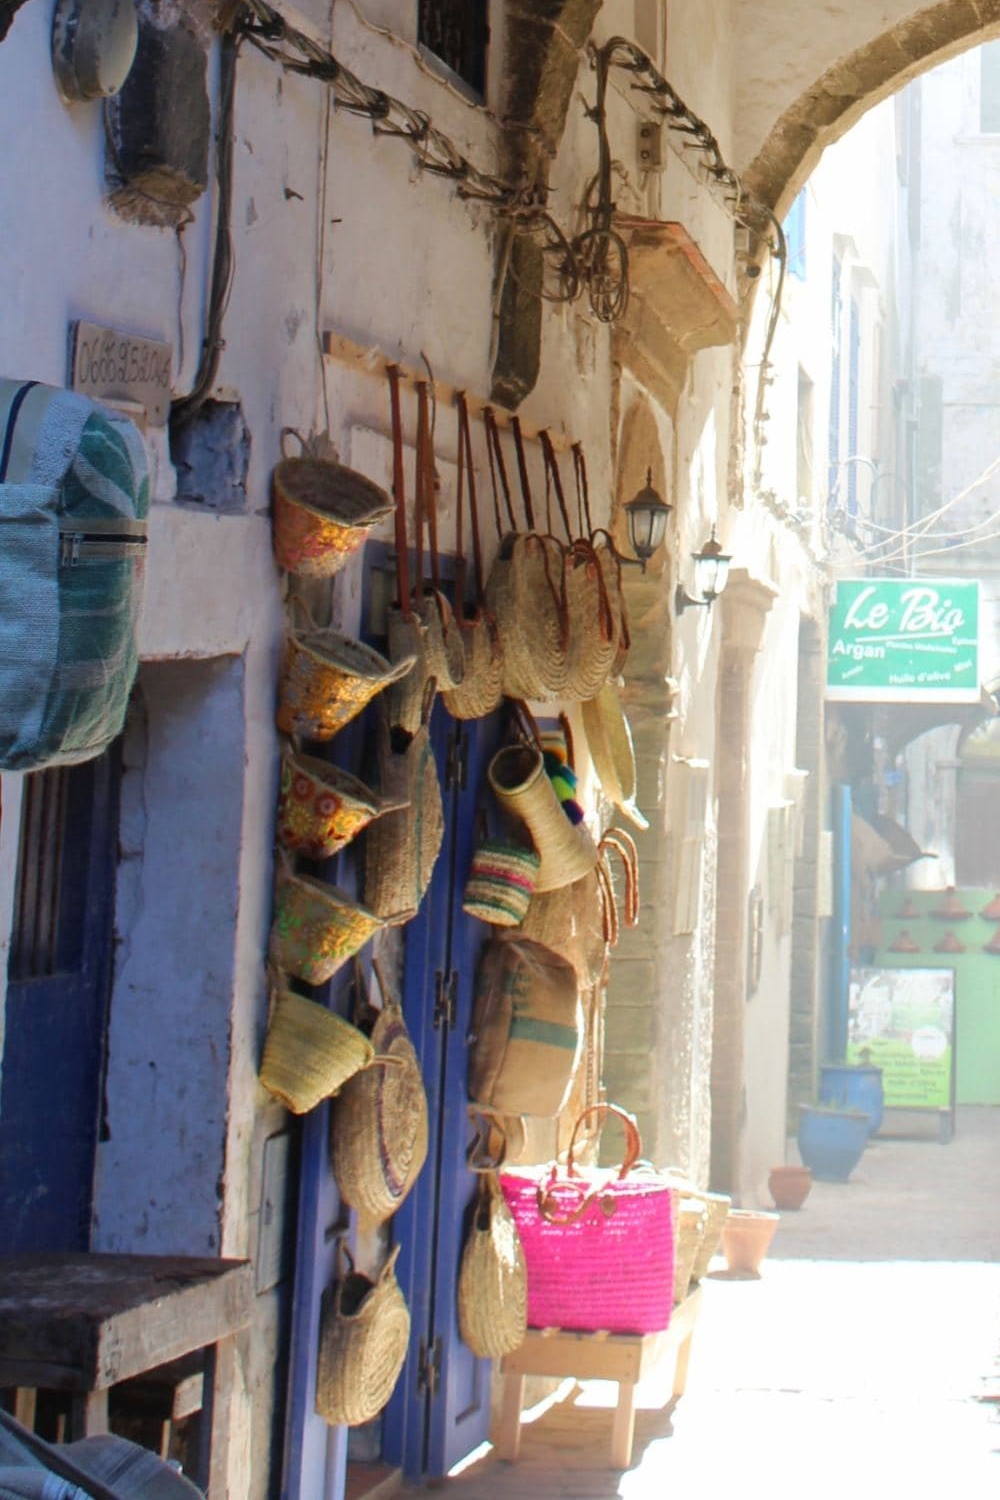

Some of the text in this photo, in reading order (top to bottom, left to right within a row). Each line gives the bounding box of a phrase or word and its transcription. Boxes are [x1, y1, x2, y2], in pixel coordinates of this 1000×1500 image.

[843, 586, 965, 632] Le Bio
[832, 639, 885, 660] Argan
